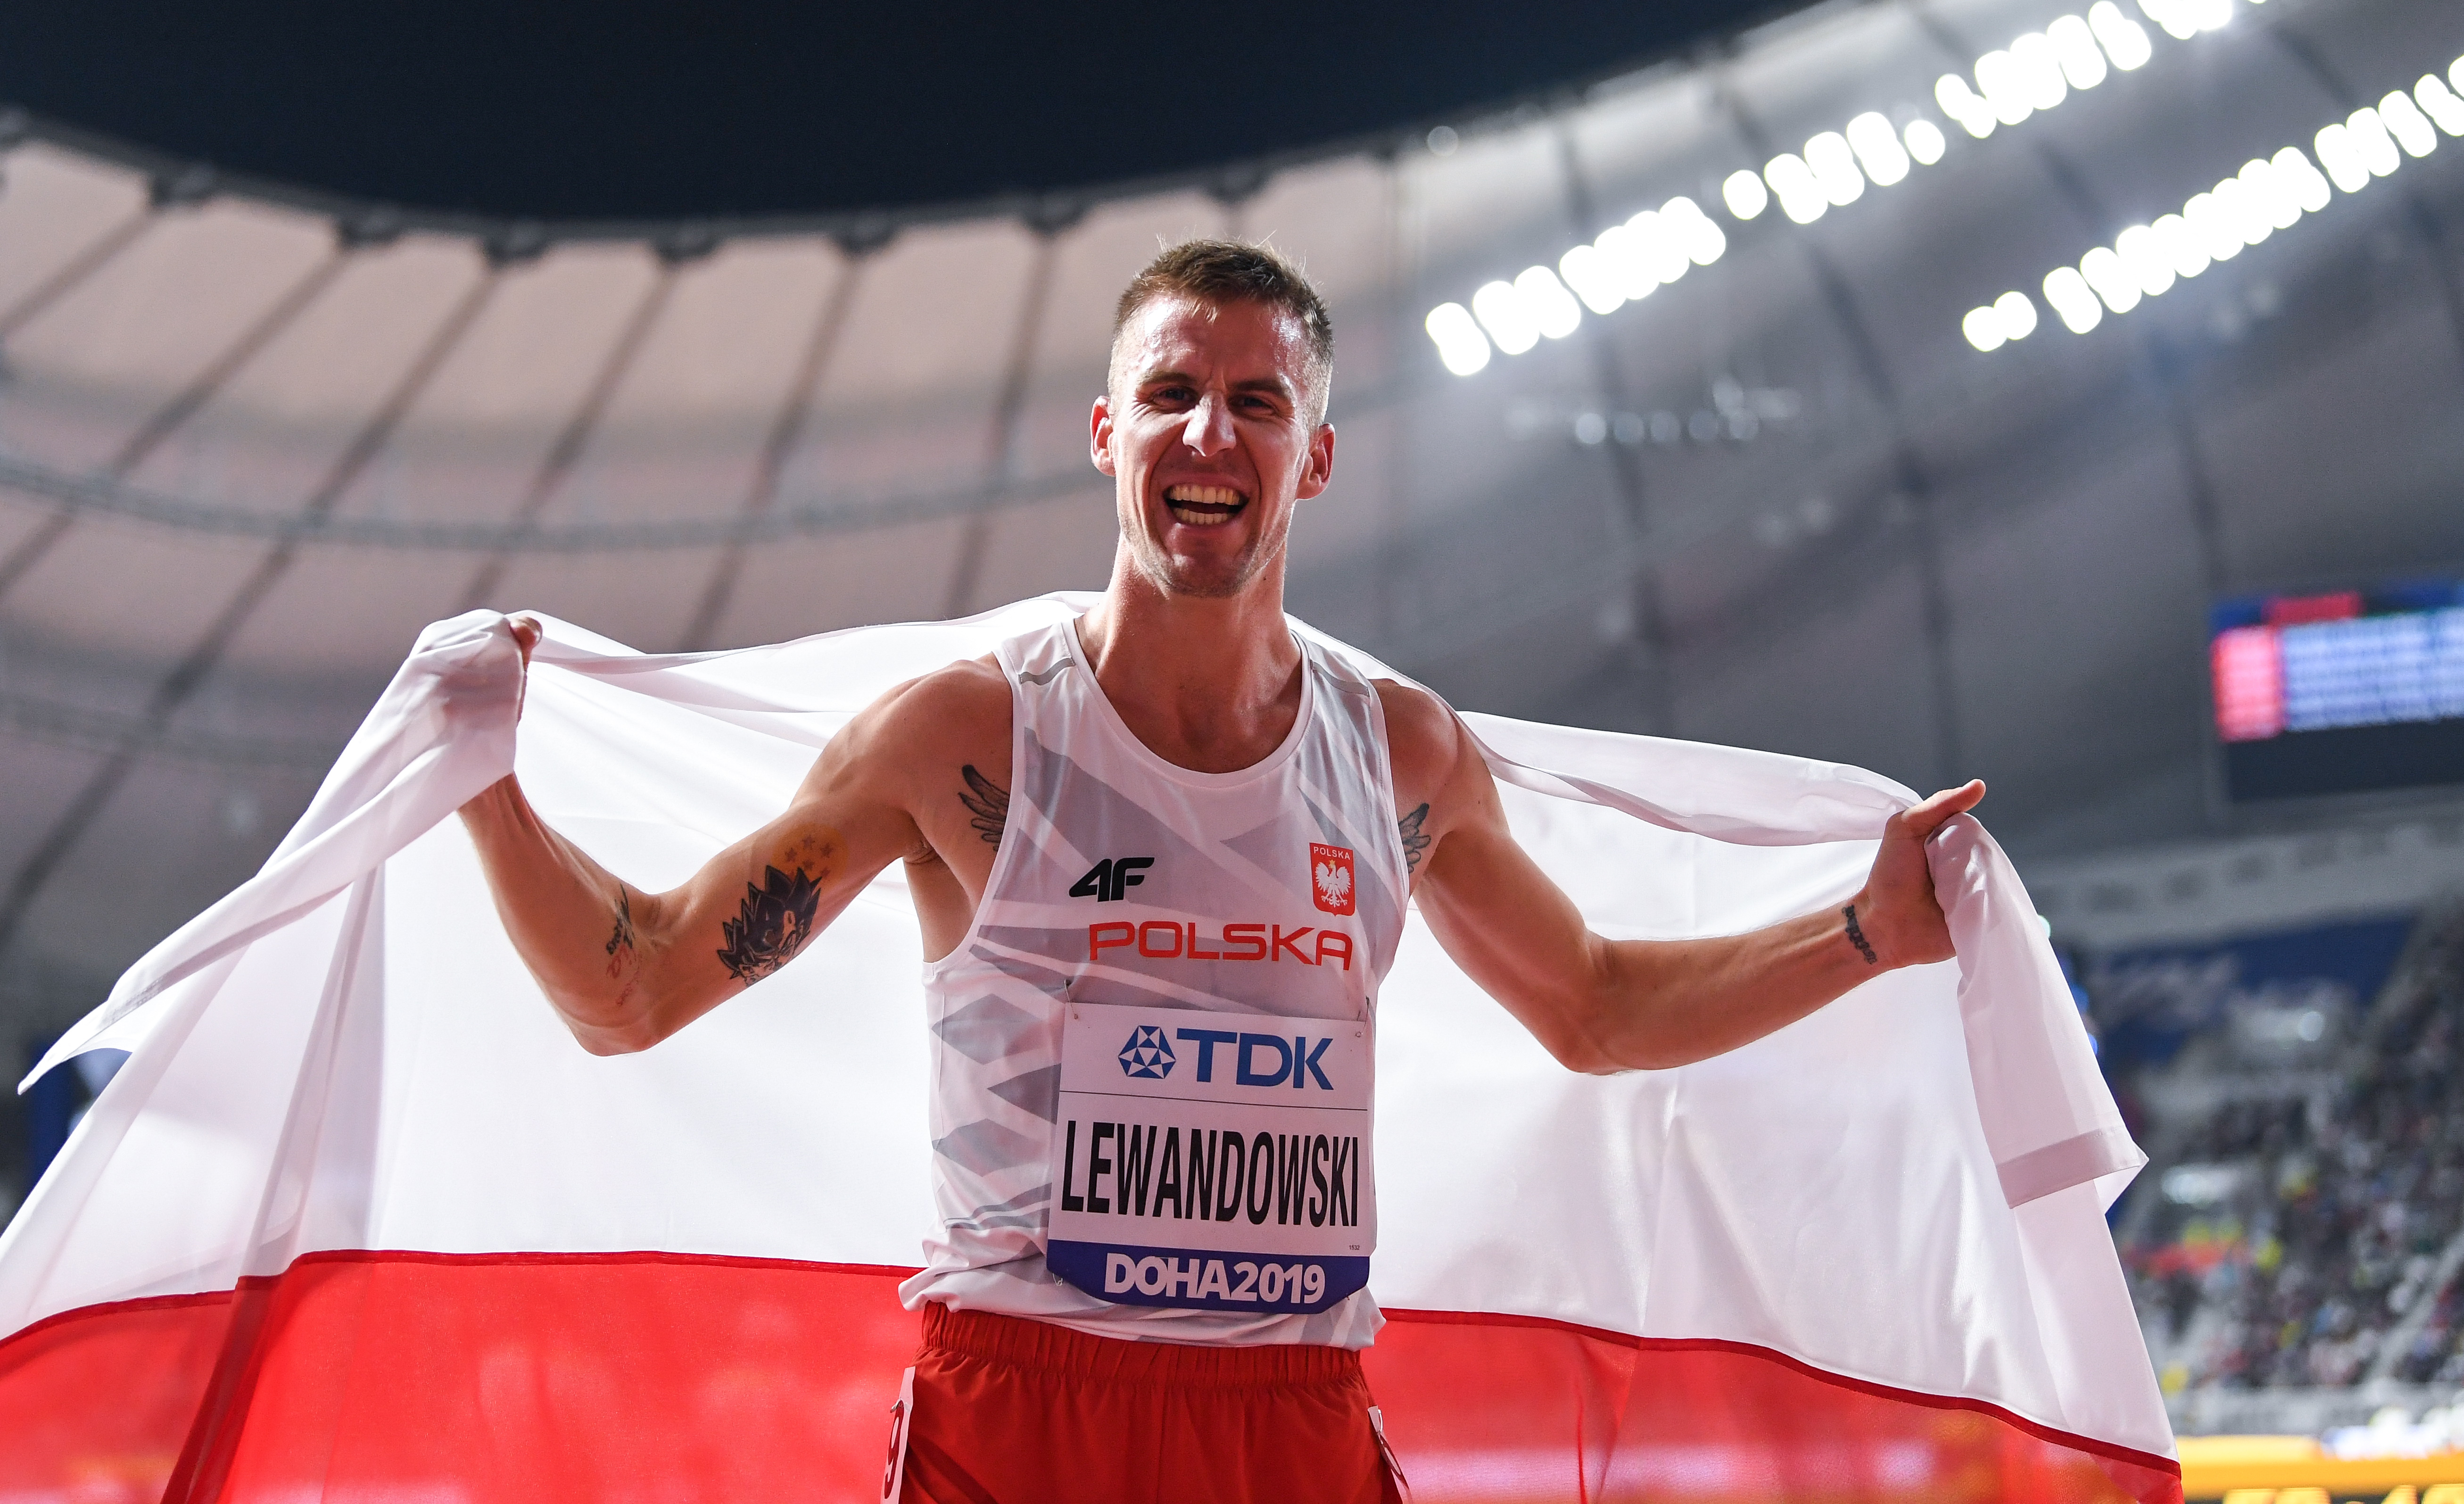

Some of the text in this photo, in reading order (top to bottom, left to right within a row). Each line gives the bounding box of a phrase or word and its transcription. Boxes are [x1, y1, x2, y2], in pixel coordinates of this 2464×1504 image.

[1313, 846, 1350, 860] POLSKA
[1069, 856, 1155, 902] 4F
[1089, 920, 1353, 971] POLSKA
[1177, 1028, 1334, 1090] TDK
[1061, 1120, 1359, 1227] LEWANDOWSKI
